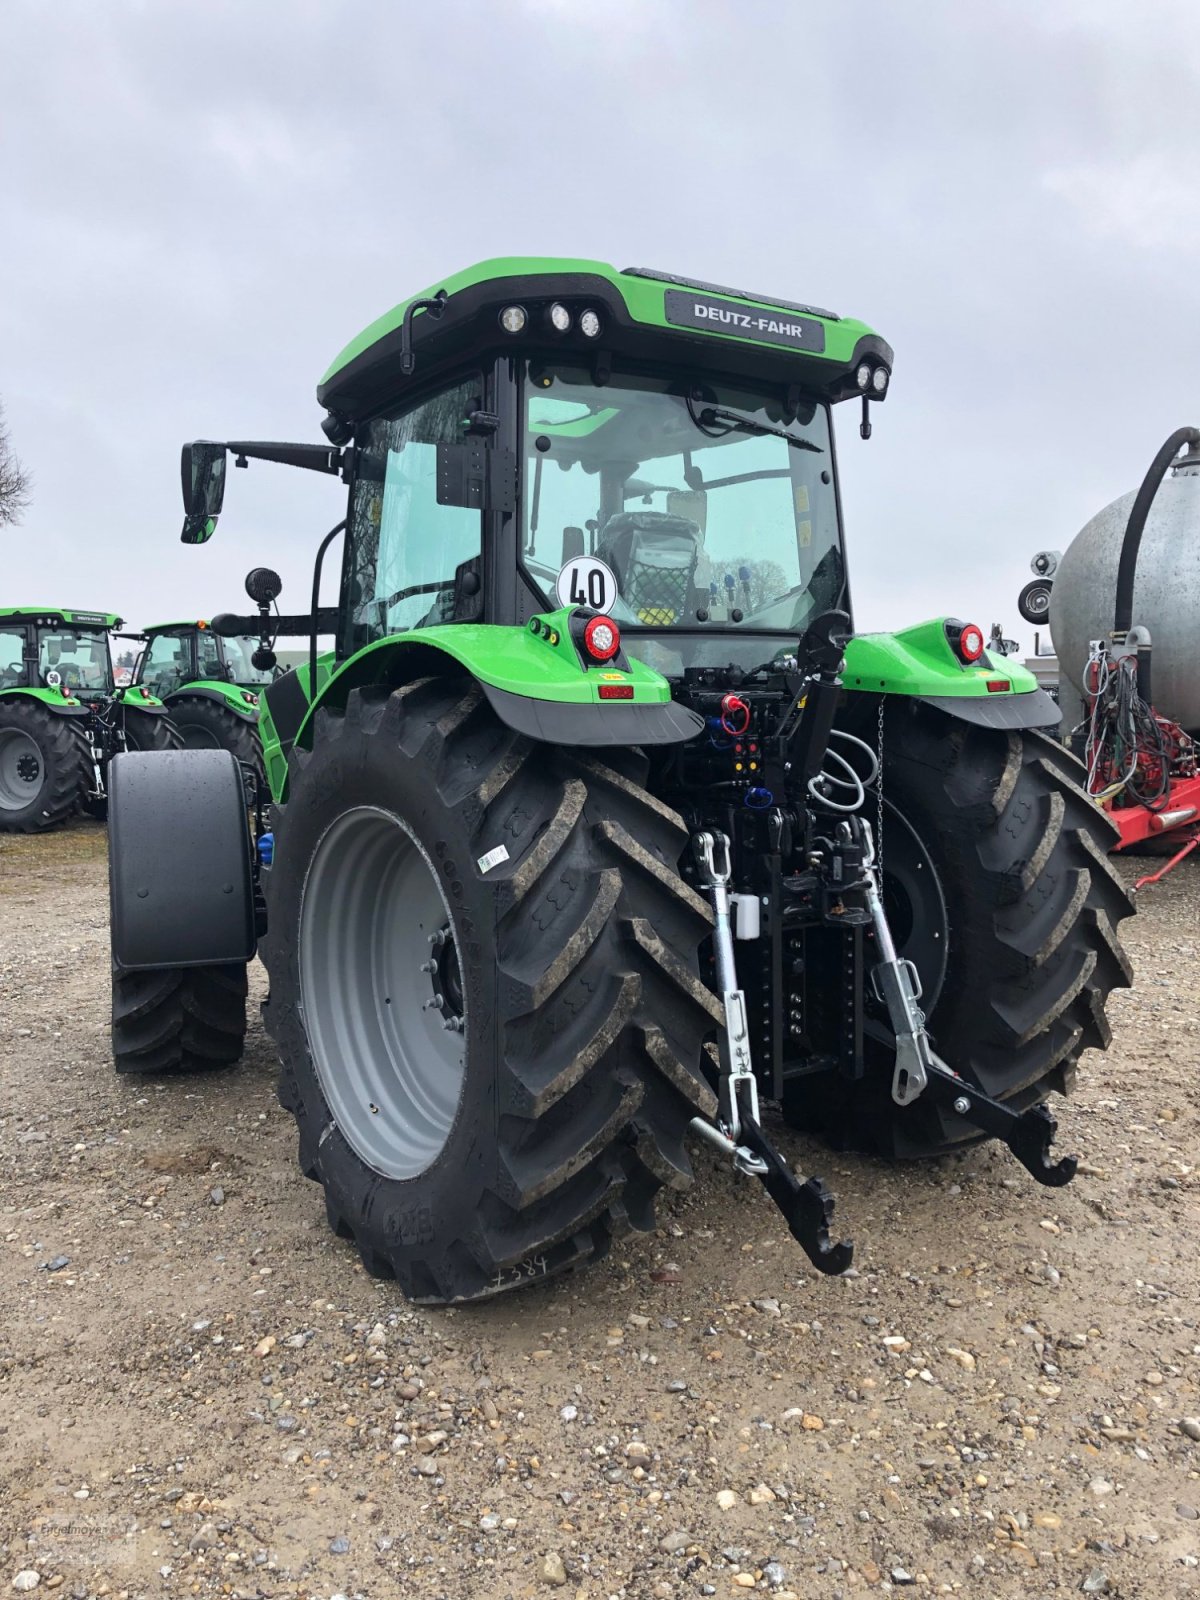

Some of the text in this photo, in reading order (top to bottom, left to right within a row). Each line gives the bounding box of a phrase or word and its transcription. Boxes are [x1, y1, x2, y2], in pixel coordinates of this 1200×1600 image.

[694, 303, 803, 338] DEUTZ-FAHR
[570, 568, 606, 610] 40
[49, 673, 59, 684] 50
